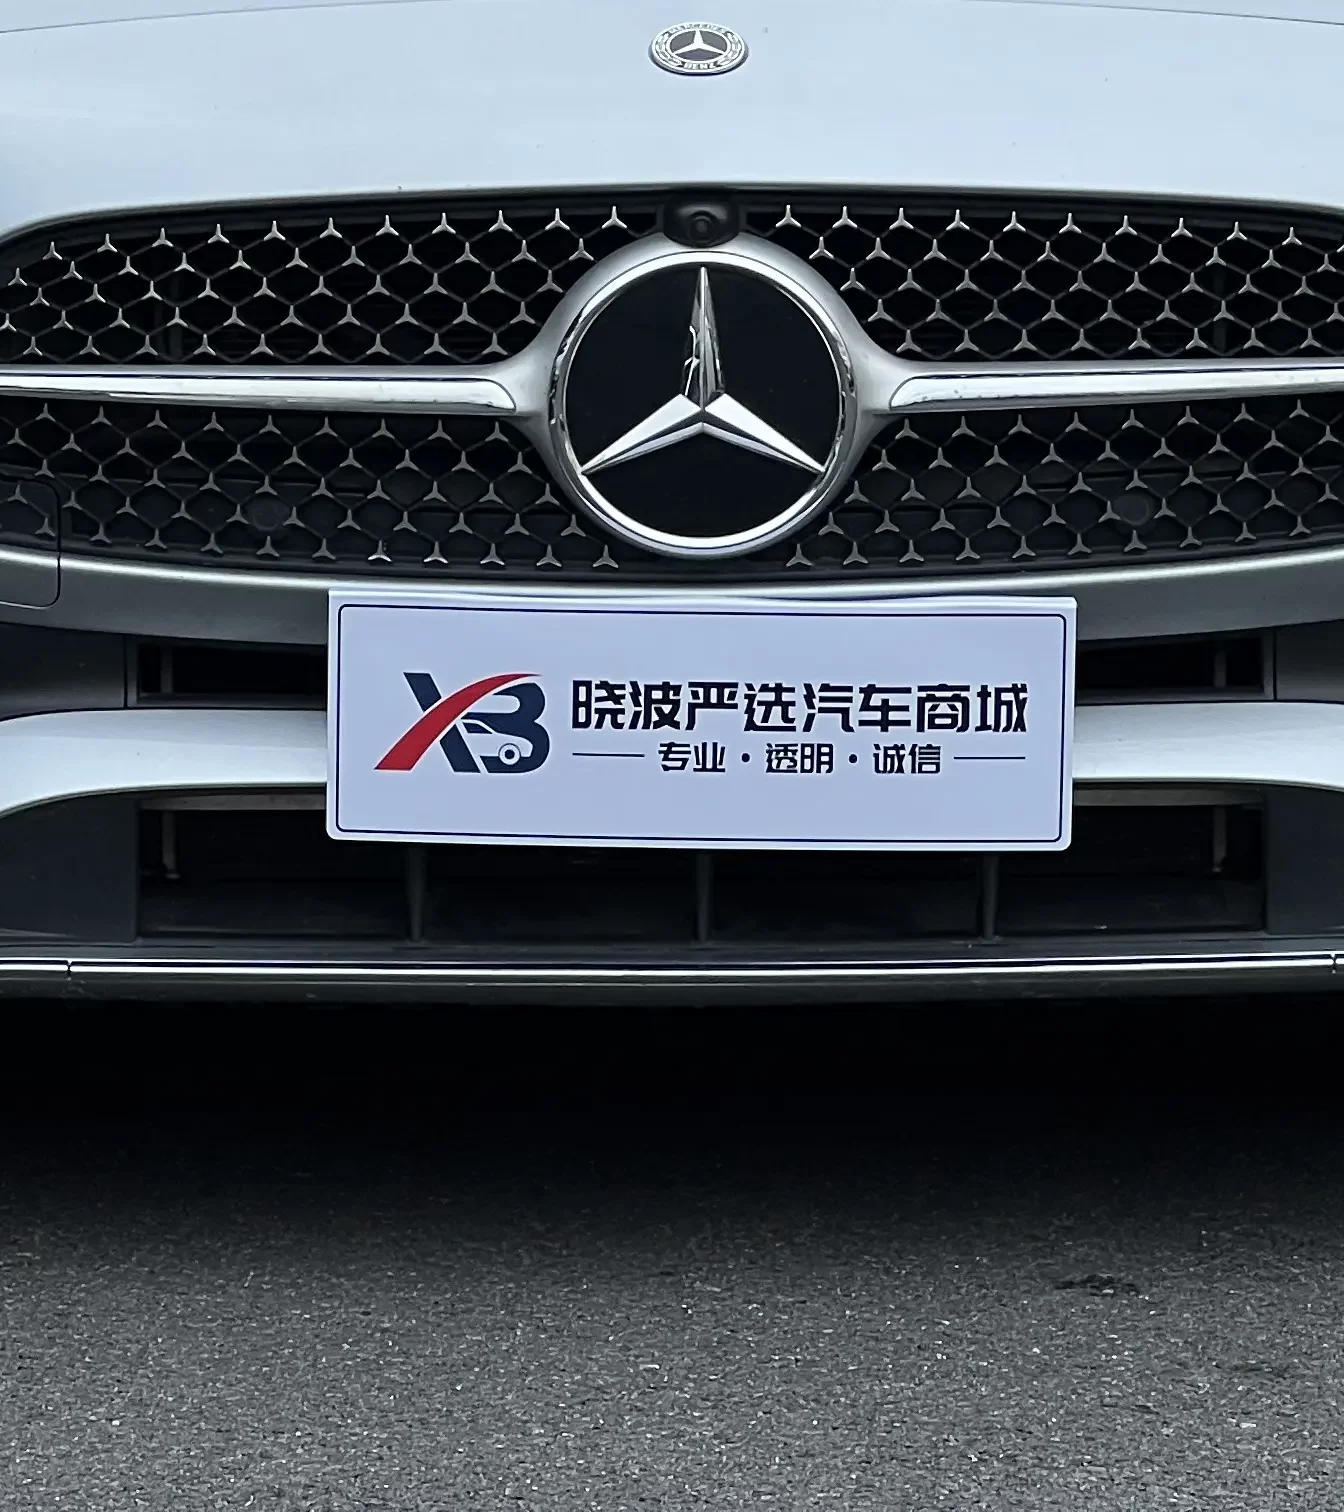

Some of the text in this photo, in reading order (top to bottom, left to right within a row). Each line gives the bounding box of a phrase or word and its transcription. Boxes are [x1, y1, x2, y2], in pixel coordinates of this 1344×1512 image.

[572, 680, 1028, 733] 晓波严选汽车商城
